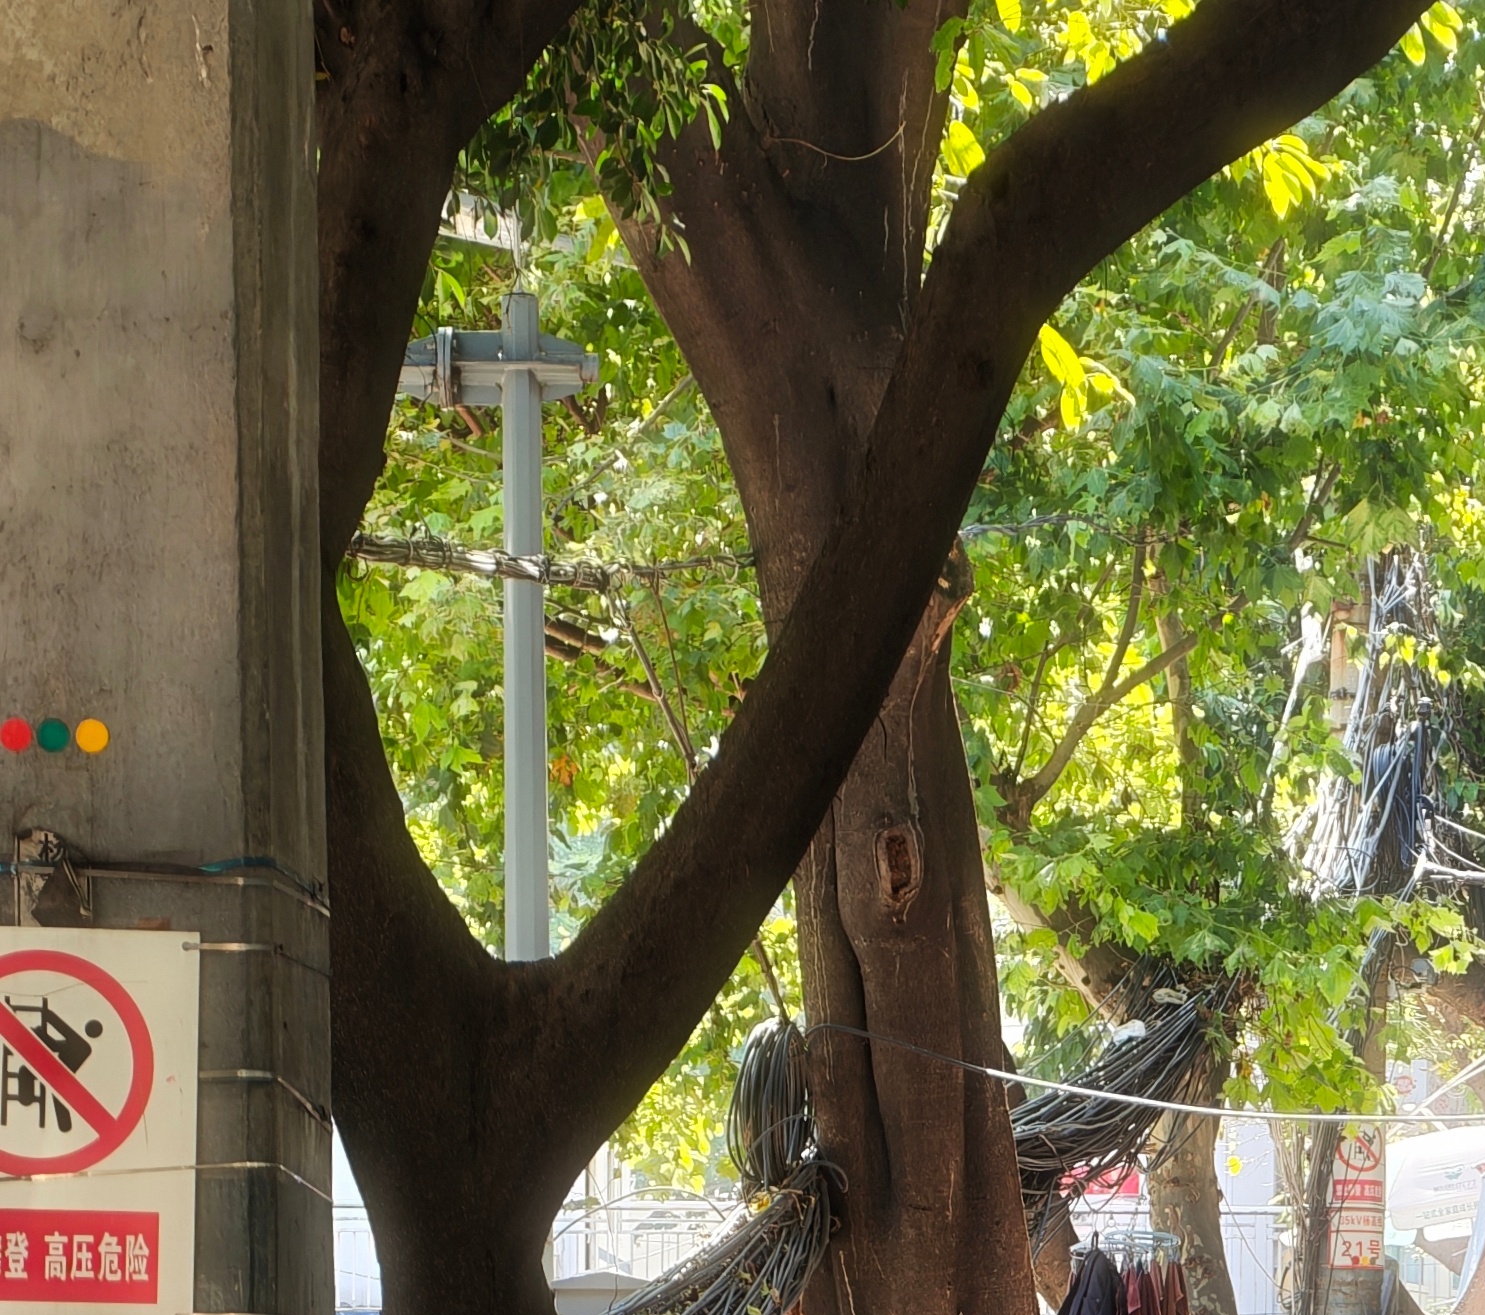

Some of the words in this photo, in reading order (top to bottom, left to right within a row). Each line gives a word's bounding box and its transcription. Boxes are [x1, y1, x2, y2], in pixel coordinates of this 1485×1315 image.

[0, 1231, 29, 1280] 登
[44, 1231, 150, 1282] 高压危险
